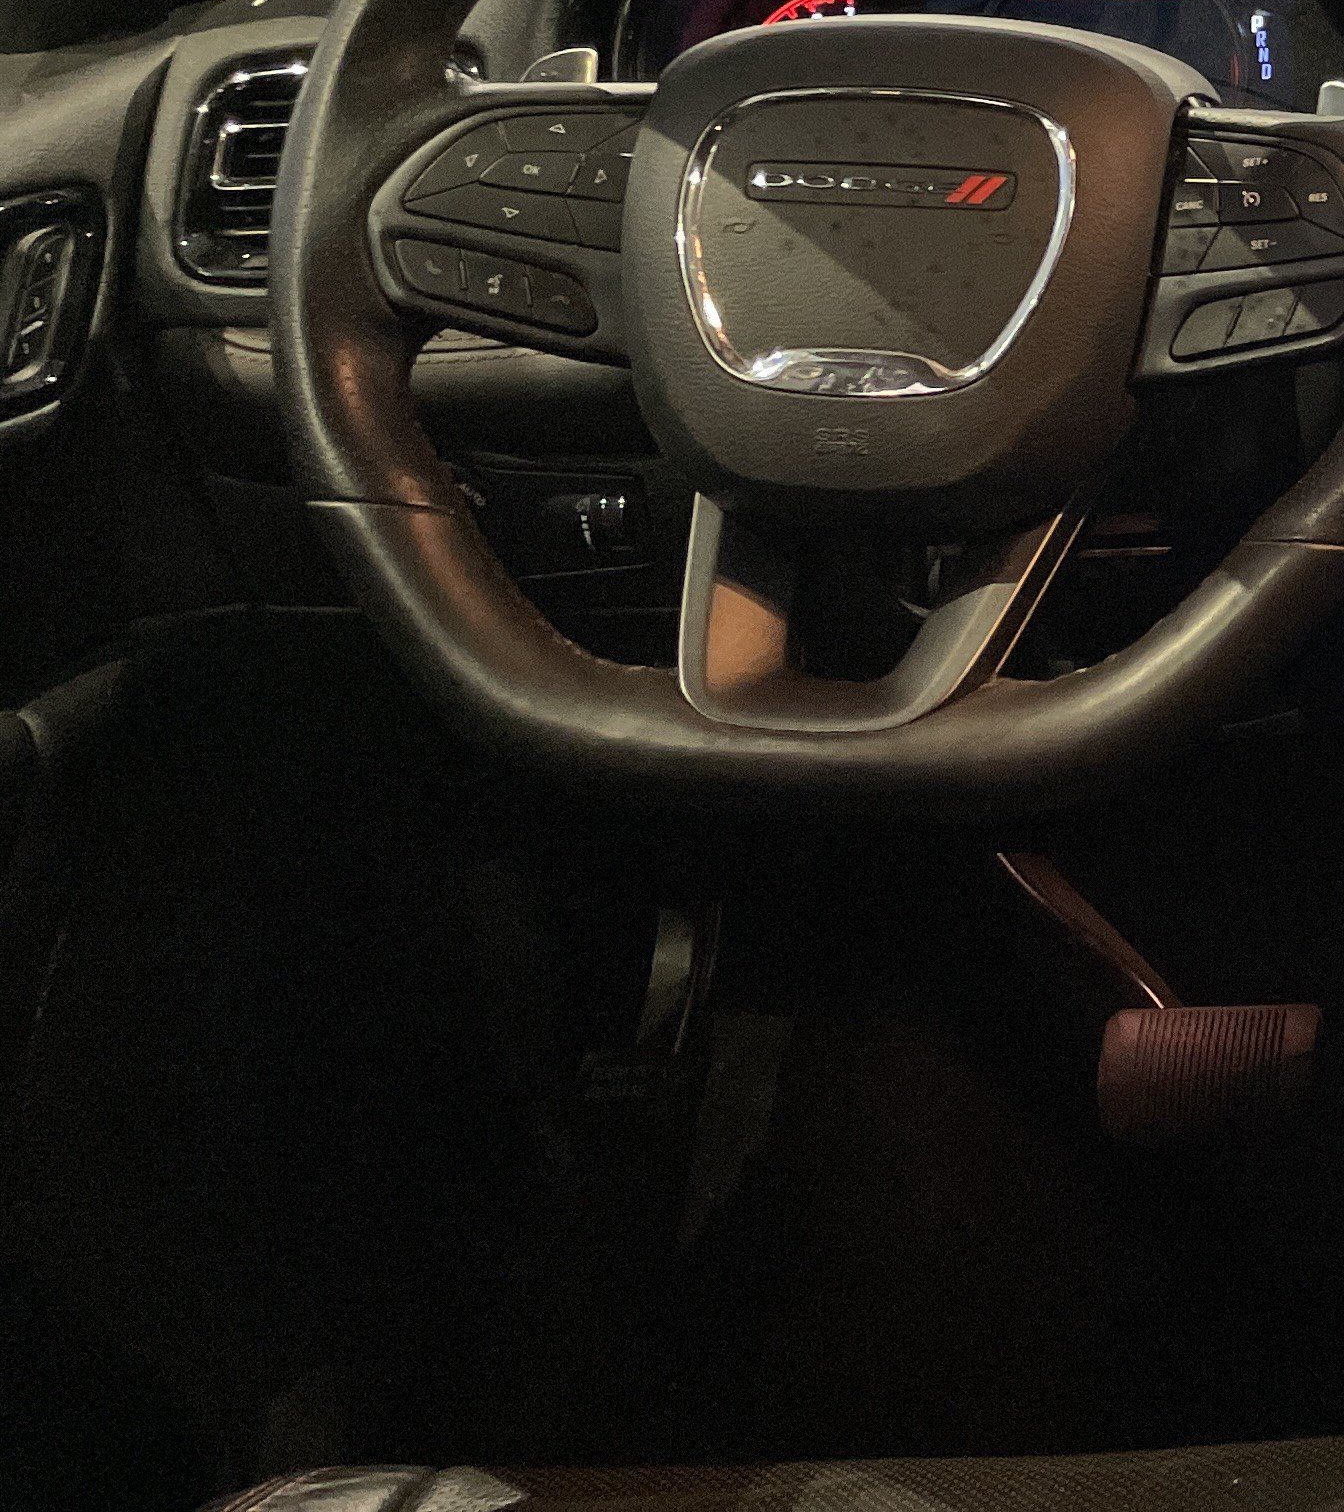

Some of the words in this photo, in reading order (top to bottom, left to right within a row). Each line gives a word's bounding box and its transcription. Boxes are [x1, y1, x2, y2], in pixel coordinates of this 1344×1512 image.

[1251, 15, 1264, 33] P
[1256, 31, 1268, 47] R
[1261, 63, 1273, 80] D
[522, 164, 541, 175] OK
